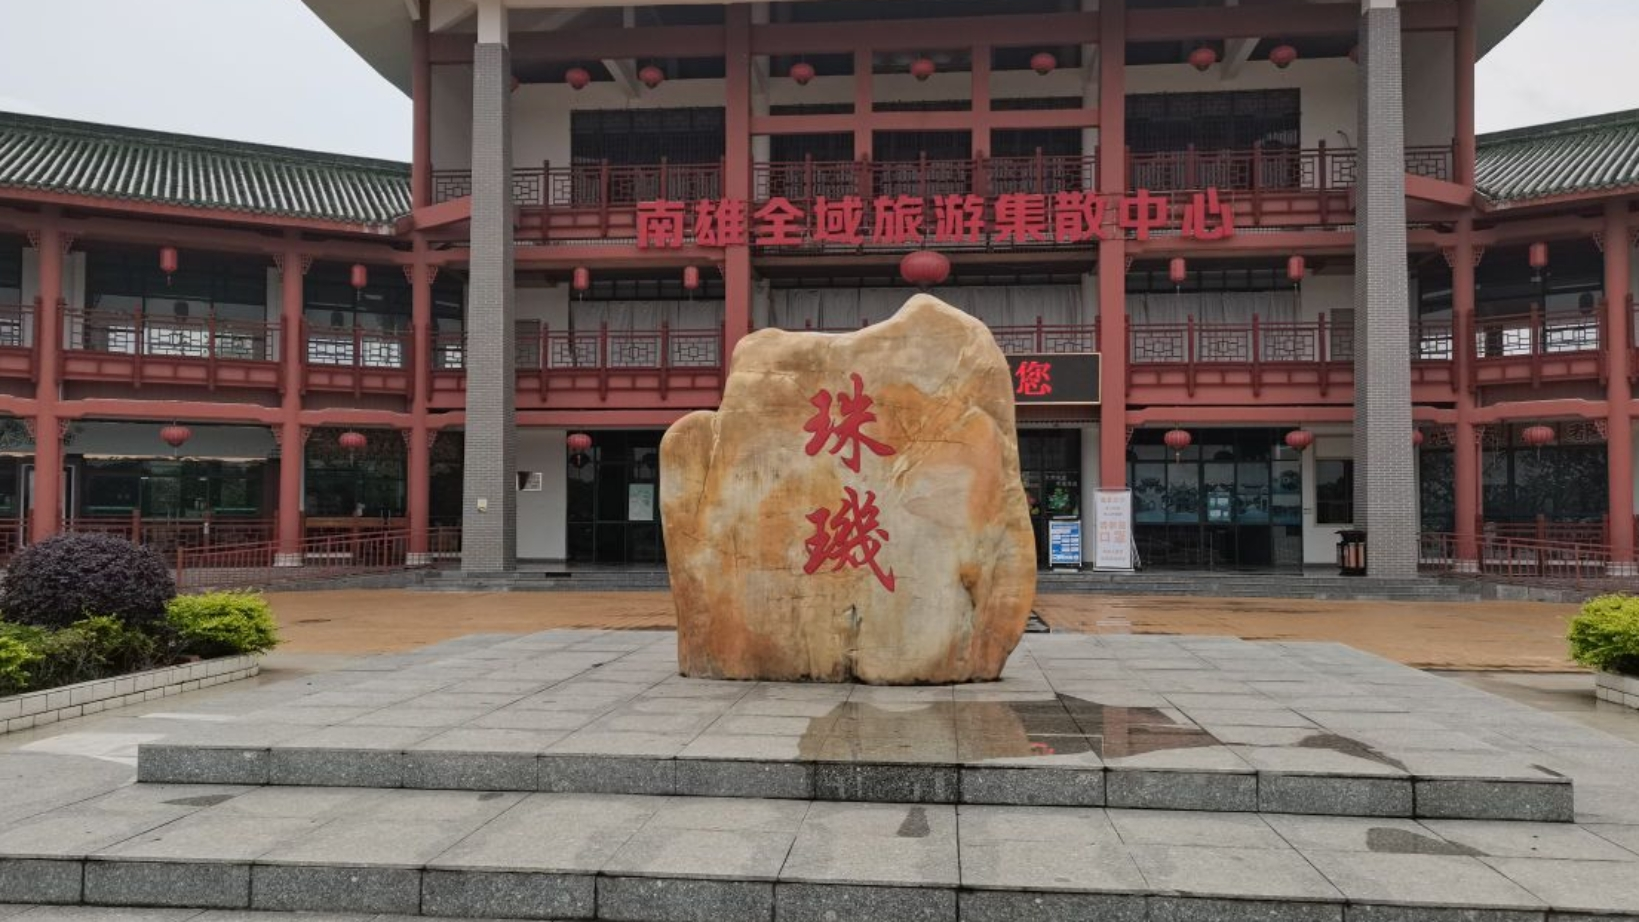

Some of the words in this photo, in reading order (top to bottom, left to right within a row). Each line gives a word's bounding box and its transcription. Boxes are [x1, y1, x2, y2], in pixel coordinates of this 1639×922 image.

[637, 187, 1235, 249] 南雄全域旅游集散中心
[1015, 361, 1052, 395] 您
